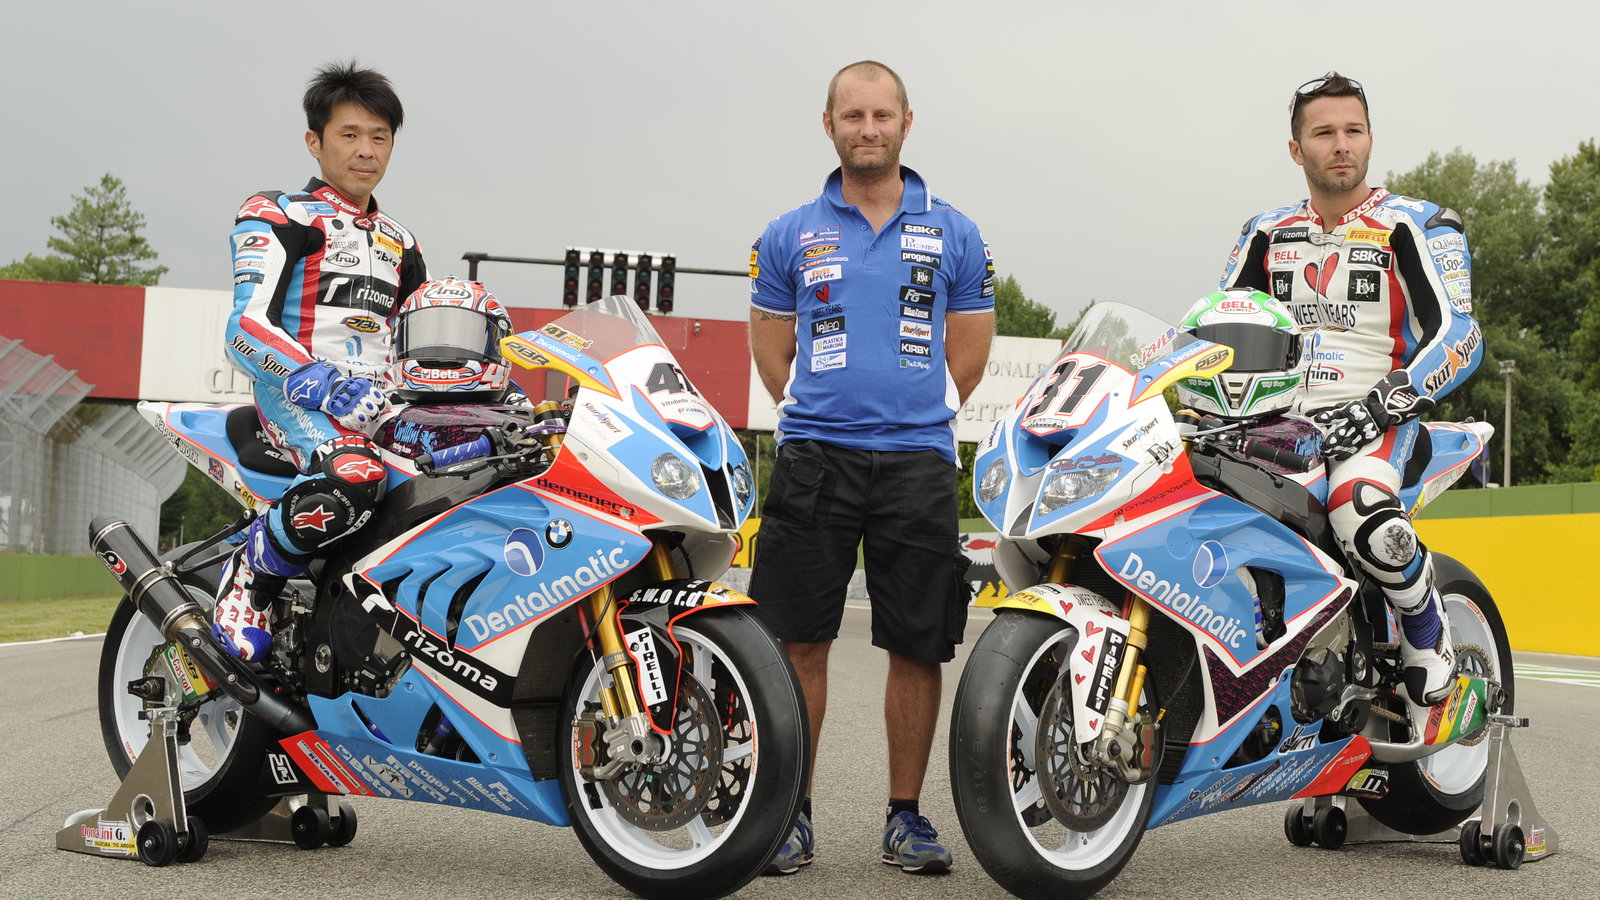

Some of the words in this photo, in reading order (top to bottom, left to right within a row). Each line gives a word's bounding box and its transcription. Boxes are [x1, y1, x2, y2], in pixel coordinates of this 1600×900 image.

[1282, 231, 1307, 239] rizoma
[1349, 230, 1387, 242] PIRELLI
[902, 252, 931, 263] progea
[1274, 250, 1300, 261] BELL
[356, 285, 395, 309] rizoma
[1221, 301, 1256, 310] BELL
[1321, 303, 1357, 328] YEARS
[229, 334, 257, 357] Star
[257, 352, 291, 379] Spor
[504, 342, 550, 366] PBR
[901, 343, 930, 355] KIRBY
[1195, 349, 1230, 371] PBR
[1423, 362, 1452, 395] Star
[1455, 325, 1482, 364] Sport
[431, 368, 460, 380] Beta
[1025, 359, 1110, 419] 31
[1122, 432, 1139, 451] Star
[1140, 416, 1160, 437] Sport
[464, 547, 631, 643] Dentalmatic
[1014, 591, 1042, 604] eni
[1118, 552, 1247, 649] Dentalmatic
[172, 657, 192, 693] Castrol
[404, 630, 499, 692] rizoma
[638, 631, 663, 700] PIRELLI
[1094, 632, 1124, 710] PIRELLI
[308, 752, 341, 788] REVARC
[349, 757, 392, 797] Beta
[407, 760, 450, 793] progea
